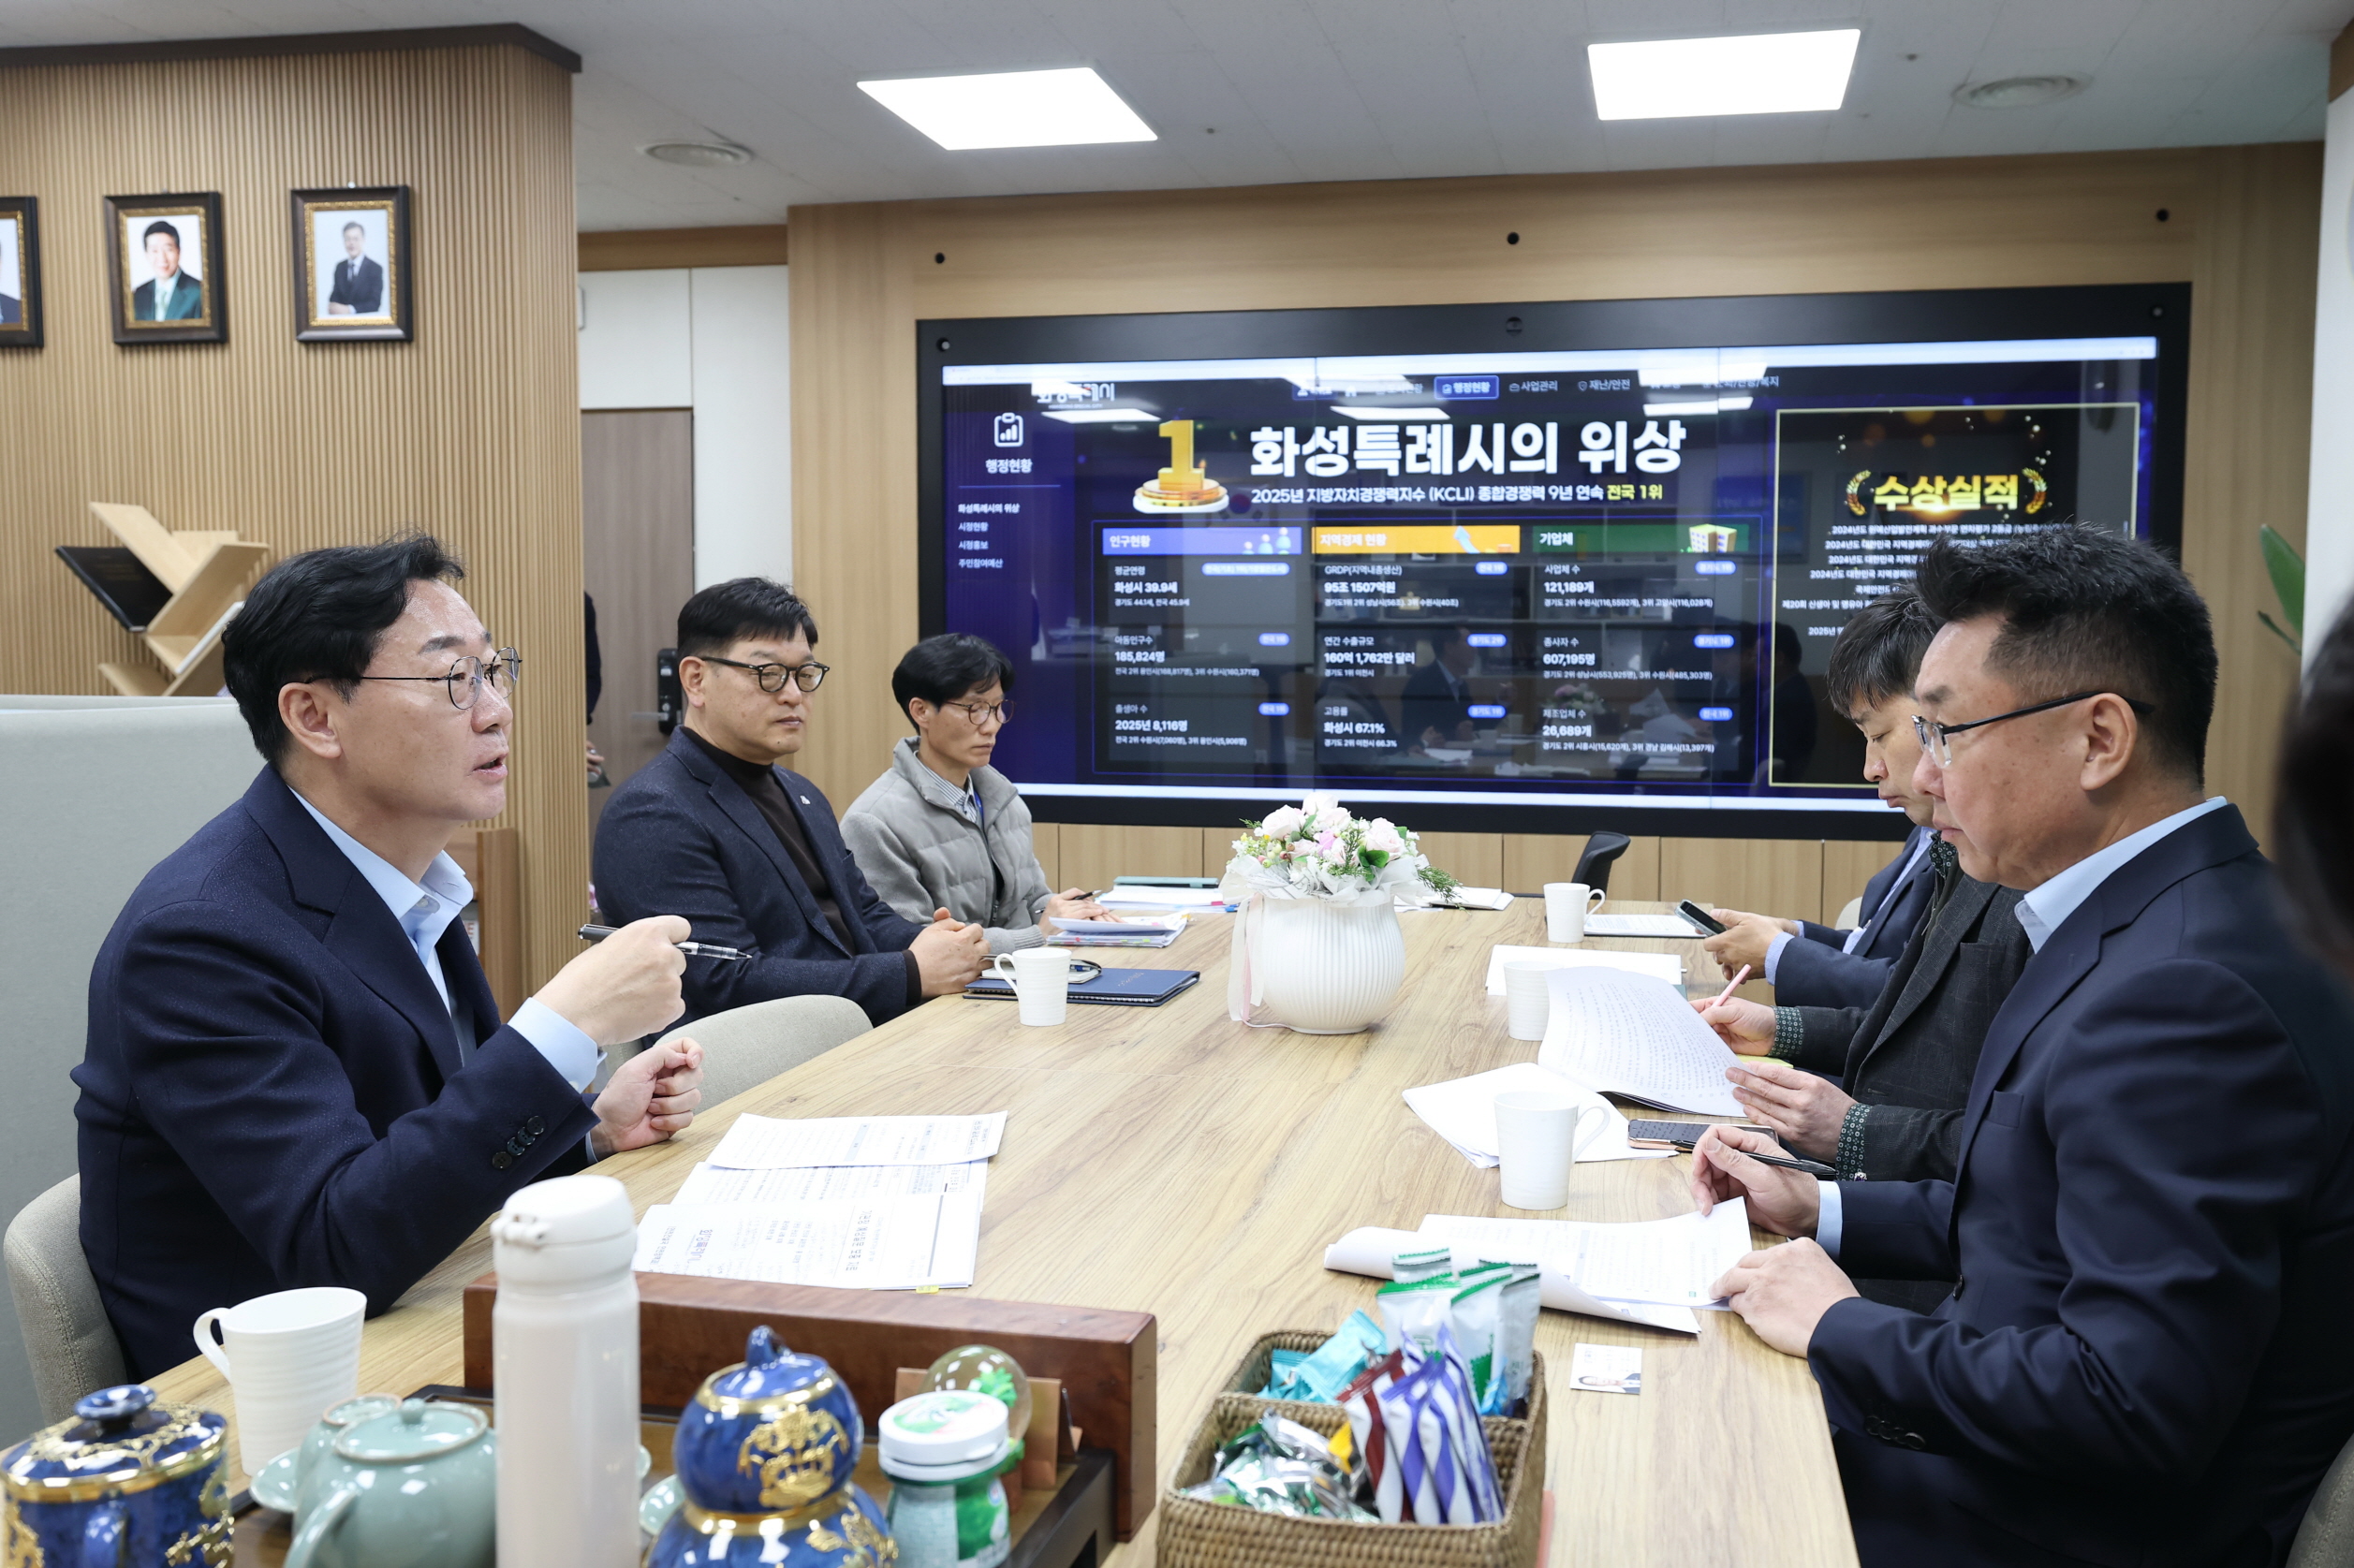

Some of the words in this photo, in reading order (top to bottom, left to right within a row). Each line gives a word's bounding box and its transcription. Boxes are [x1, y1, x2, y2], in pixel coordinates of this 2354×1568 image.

[1453, 382, 1491, 393] 행정현황
[1521, 380, 1558, 391] 사업관리
[1589, 379, 1630, 390] 재난/안전
[1250, 422, 1558, 477] 화성특례시의
[1579, 419, 1686, 474] 위상
[985, 459, 1033, 474] 행정현황
[1251, 489, 1303, 504] 2025년
[1306, 487, 1425, 504] 지방자치경쟁력지수
[1429, 487, 1475, 502] (KCLI)
[1478, 485, 1545, 502] 종합경쟁력
[1548, 485, 1573, 501] 9년
[1576, 485, 1604, 500] 연속
[1607, 484, 1635, 500] 전국
[1640, 484, 1663, 500] 1위
[1874, 474, 2019, 512] 수상실적
[958, 504, 1003, 514] 화성특례시의
[1004, 503, 1021, 514] 위상
[958, 522, 989, 532] 시정현황
[1832, 525, 1867, 535] 2024년도
[1110, 535, 1151, 549] 인구현황
[1320, 534, 1363, 547] 지역경제
[1365, 534, 1388, 546] 현황
[1539, 533, 1573, 546] 기업체
[1825, 540, 1860, 550] 2024년도
[1861, 540, 1891, 550] 대한민국
[958, 558, 1004, 569] 주민참여예산
[1828, 554, 1863, 564] 2024년도
[1864, 554, 1894, 564] 대한민국
[1114, 565, 1145, 577] 평균연령
[1324, 565, 1403, 577] GRDP(지역내총생산)
[1545, 564, 1569, 575] 사업체
[1571, 564, 1581, 575] 수
[1809, 569, 1845, 579] 2024년도
[1846, 569, 1876, 579] 대한민국
[1114, 582, 1142, 593] 화성시
[1144, 581, 1178, 593] 39.9세
[1324, 582, 1348, 593] 95조
[1350, 581, 1395, 593] 1507억원
[1543, 580, 1594, 595] 121,189개
[1782, 600, 1807, 609] 제20회
[1809, 600, 1831, 609] 신생아
[1832, 600, 1839, 609] 및
[1808, 627, 1835, 637] 2025년
[1114, 636, 1154, 646] 아동인구수
[1324, 637, 1341, 646] 연간
[1343, 637, 1375, 646] 수출규모
[1543, 637, 1569, 648] 종사자
[1570, 637, 1579, 648] 수
[1114, 651, 1165, 663] 185,824명
[1324, 652, 1354, 665] 160억
[1355, 652, 1393, 665] 1,762만
[1395, 652, 1416, 665] 달러
[1543, 653, 1596, 667] 607,195명
[1324, 669, 1343, 678] 경기도
[1345, 669, 1354, 678] 1위
[1356, 669, 1375, 678] 이천시
[1543, 670, 1562, 680] 경기도
[1564, 670, 1575, 680] 2위
[1639, 671, 1651, 680] 3위
[1115, 705, 1139, 713] 출생아
[1140, 705, 1148, 714] 수
[1324, 707, 1348, 717] 고용률
[1543, 710, 1577, 719] 제조업체
[1577, 710, 1586, 719] 수
[1114, 719, 1152, 731] 2025년
[1152, 720, 1187, 732] 8,116명
[1324, 723, 1354, 734] 화성시
[1355, 723, 1386, 734] 67.1%
[1543, 725, 1592, 738] 26,689개
[1542, 742, 1562, 751] 경기도
[1563, 742, 1575, 751] 2위
